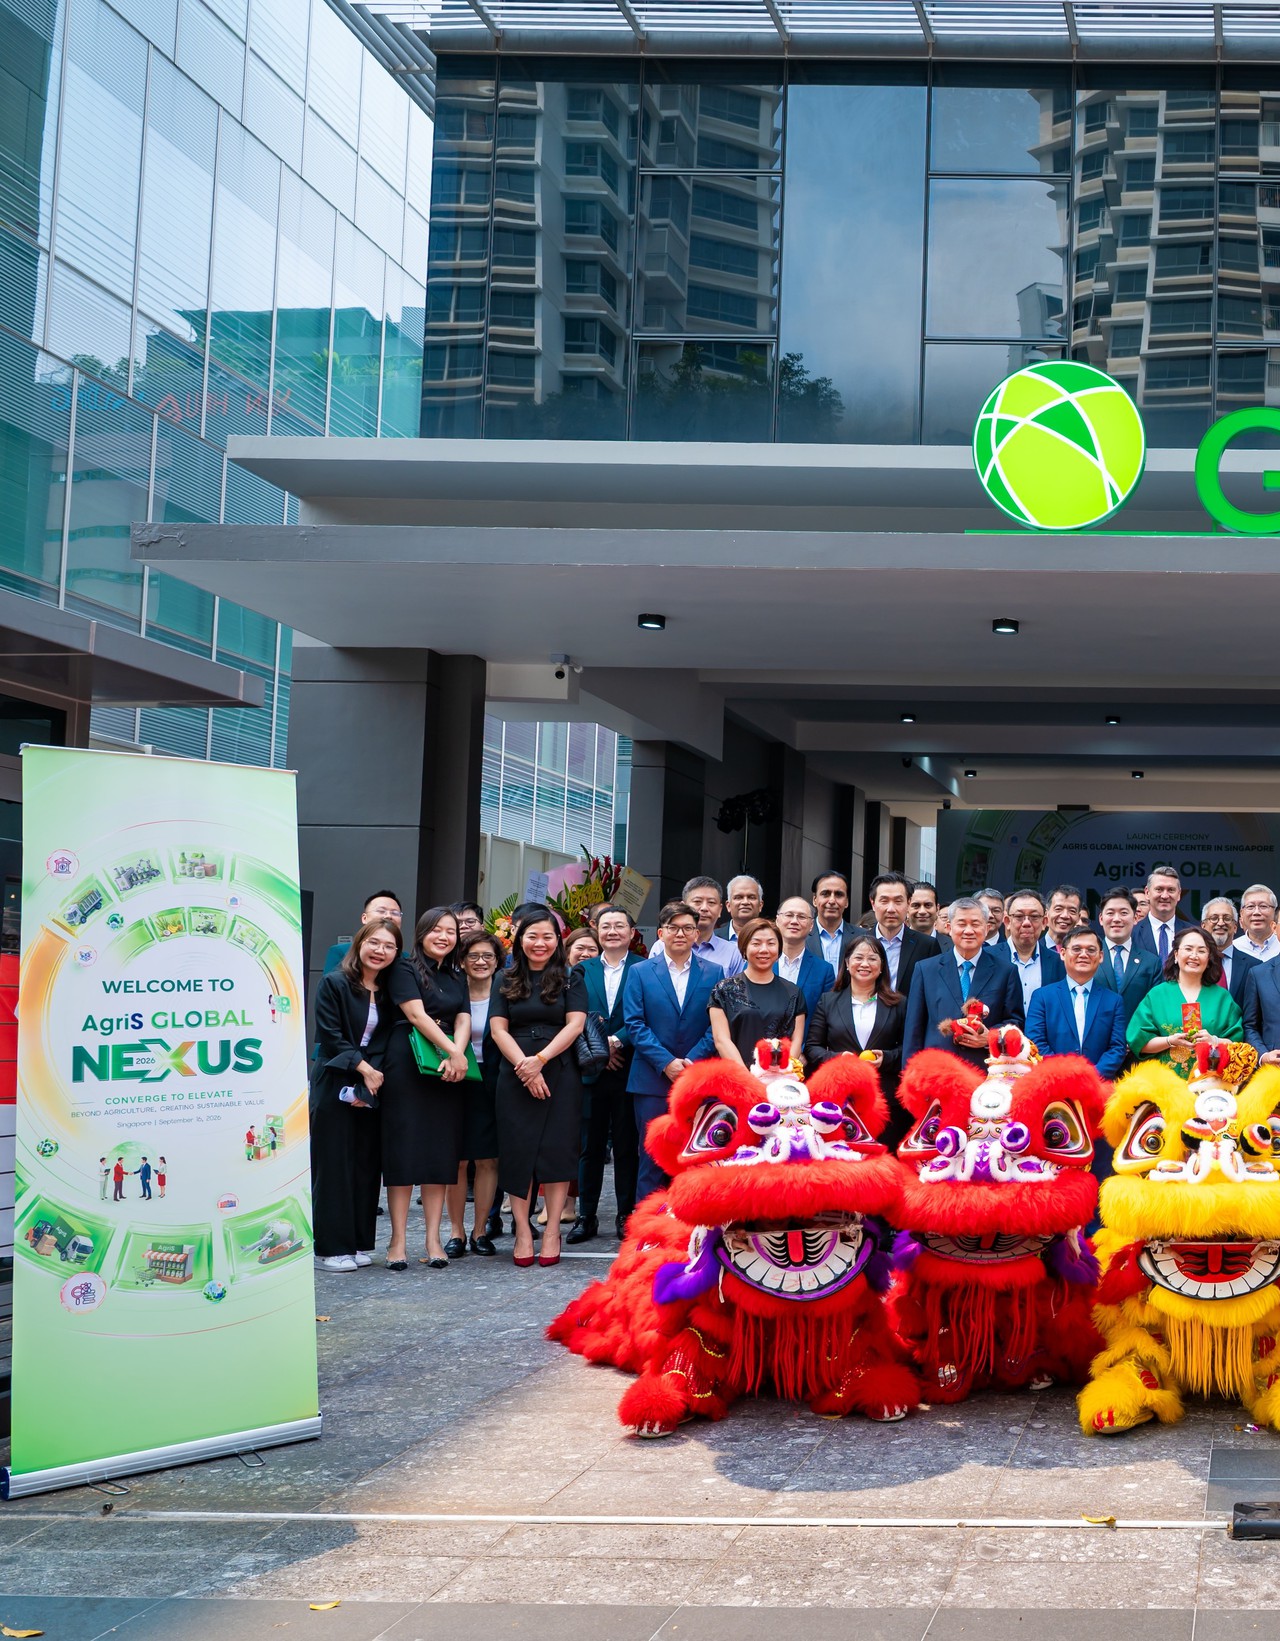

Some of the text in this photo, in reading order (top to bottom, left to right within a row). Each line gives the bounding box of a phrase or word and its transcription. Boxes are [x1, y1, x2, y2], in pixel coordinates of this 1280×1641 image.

[1126, 832, 1160, 840] LAUNCH
[1089, 843, 1123, 851] GLOBAL
[1125, 843, 1177, 851] INNOVATION
[1179, 844, 1212, 852] CENTER
[1214, 844, 1223, 852] IN
[1093, 861, 1240, 881] AgriS OBAL
[102, 978, 235, 994] WELCOME TO
[81, 1009, 254, 1036] AgriS GLOBAL
[72, 1038, 264, 1083] NEXUS
[135, 1057, 156, 1065] 2026
[105, 1090, 233, 1105] CONVERGE TO ELEVATE
[71, 1110, 102, 1118] BEYOND
[103, 1107, 157, 1116] AGRICULTURE,
[160, 1104, 194, 1112] CREATING
[197, 1101, 242, 1110] SUSTAINABLE
[116, 1120, 152, 1129] Singapore
[158, 1117, 193, 1125] September
[55, 1226, 67, 1237] AgriS
[157, 1244, 176, 1252] AgriS
